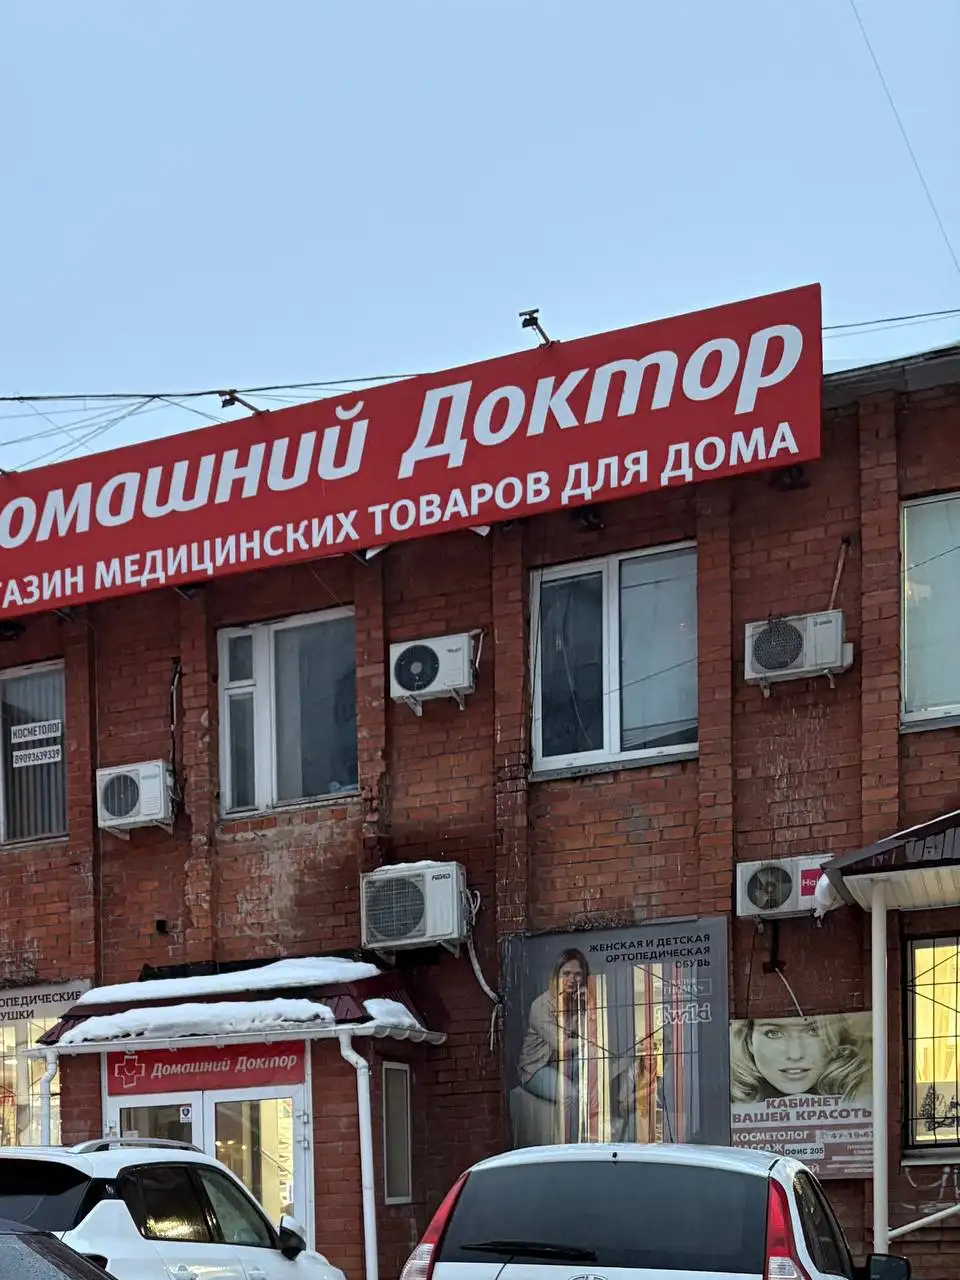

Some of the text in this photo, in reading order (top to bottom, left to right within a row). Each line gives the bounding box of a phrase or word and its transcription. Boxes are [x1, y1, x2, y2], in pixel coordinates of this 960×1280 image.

[397, 324, 803, 479] Доктор
[95, 509, 360, 590] МЕДИЦИНСКИХ
[368, 470, 549, 536] ТОВАРОВ
[561, 451, 648, 505] ДЛЯ
[660, 422, 799, 486] ДОМА
[13, 722, 60, 740] КОСМЕТОЛОГ
[589, 934, 710, 953] ЖЕНСКАЯ И ДЕТСКАЯ
[605, 946, 711, 963] ОРТОПЕДИЧЕСКАЯ
[675, 958, 711, 969] ОБУВЬ
[151, 1054, 297, 1079] Домашний Доктор
[766, 1096, 842, 1110] КАБИНЕТ
[733, 1110, 791, 1124] ВАШЕЙ
[733, 1130, 809, 1142] КОСМЕТОЛОГ
[785, 1147, 824, 1156] ОФИС 205
